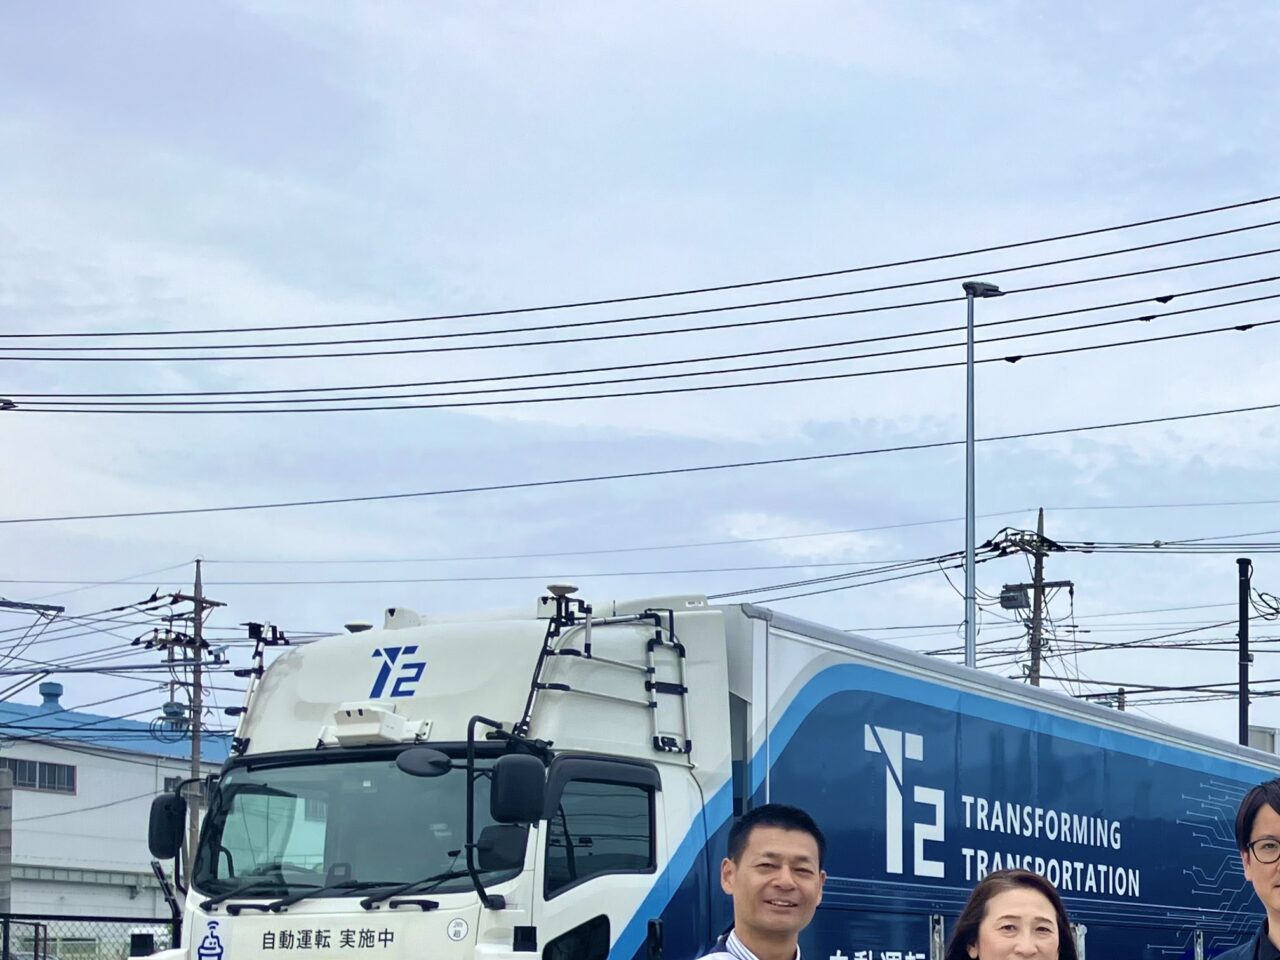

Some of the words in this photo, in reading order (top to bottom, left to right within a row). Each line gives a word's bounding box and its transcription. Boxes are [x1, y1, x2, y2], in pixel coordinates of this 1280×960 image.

[369, 645, 427, 699] T2
[864, 723, 945, 878] T2
[961, 795, 1122, 850] TRANSFORMING
[262, 929, 331, 950] 自動運転
[339, 928, 395, 949] 実施中
